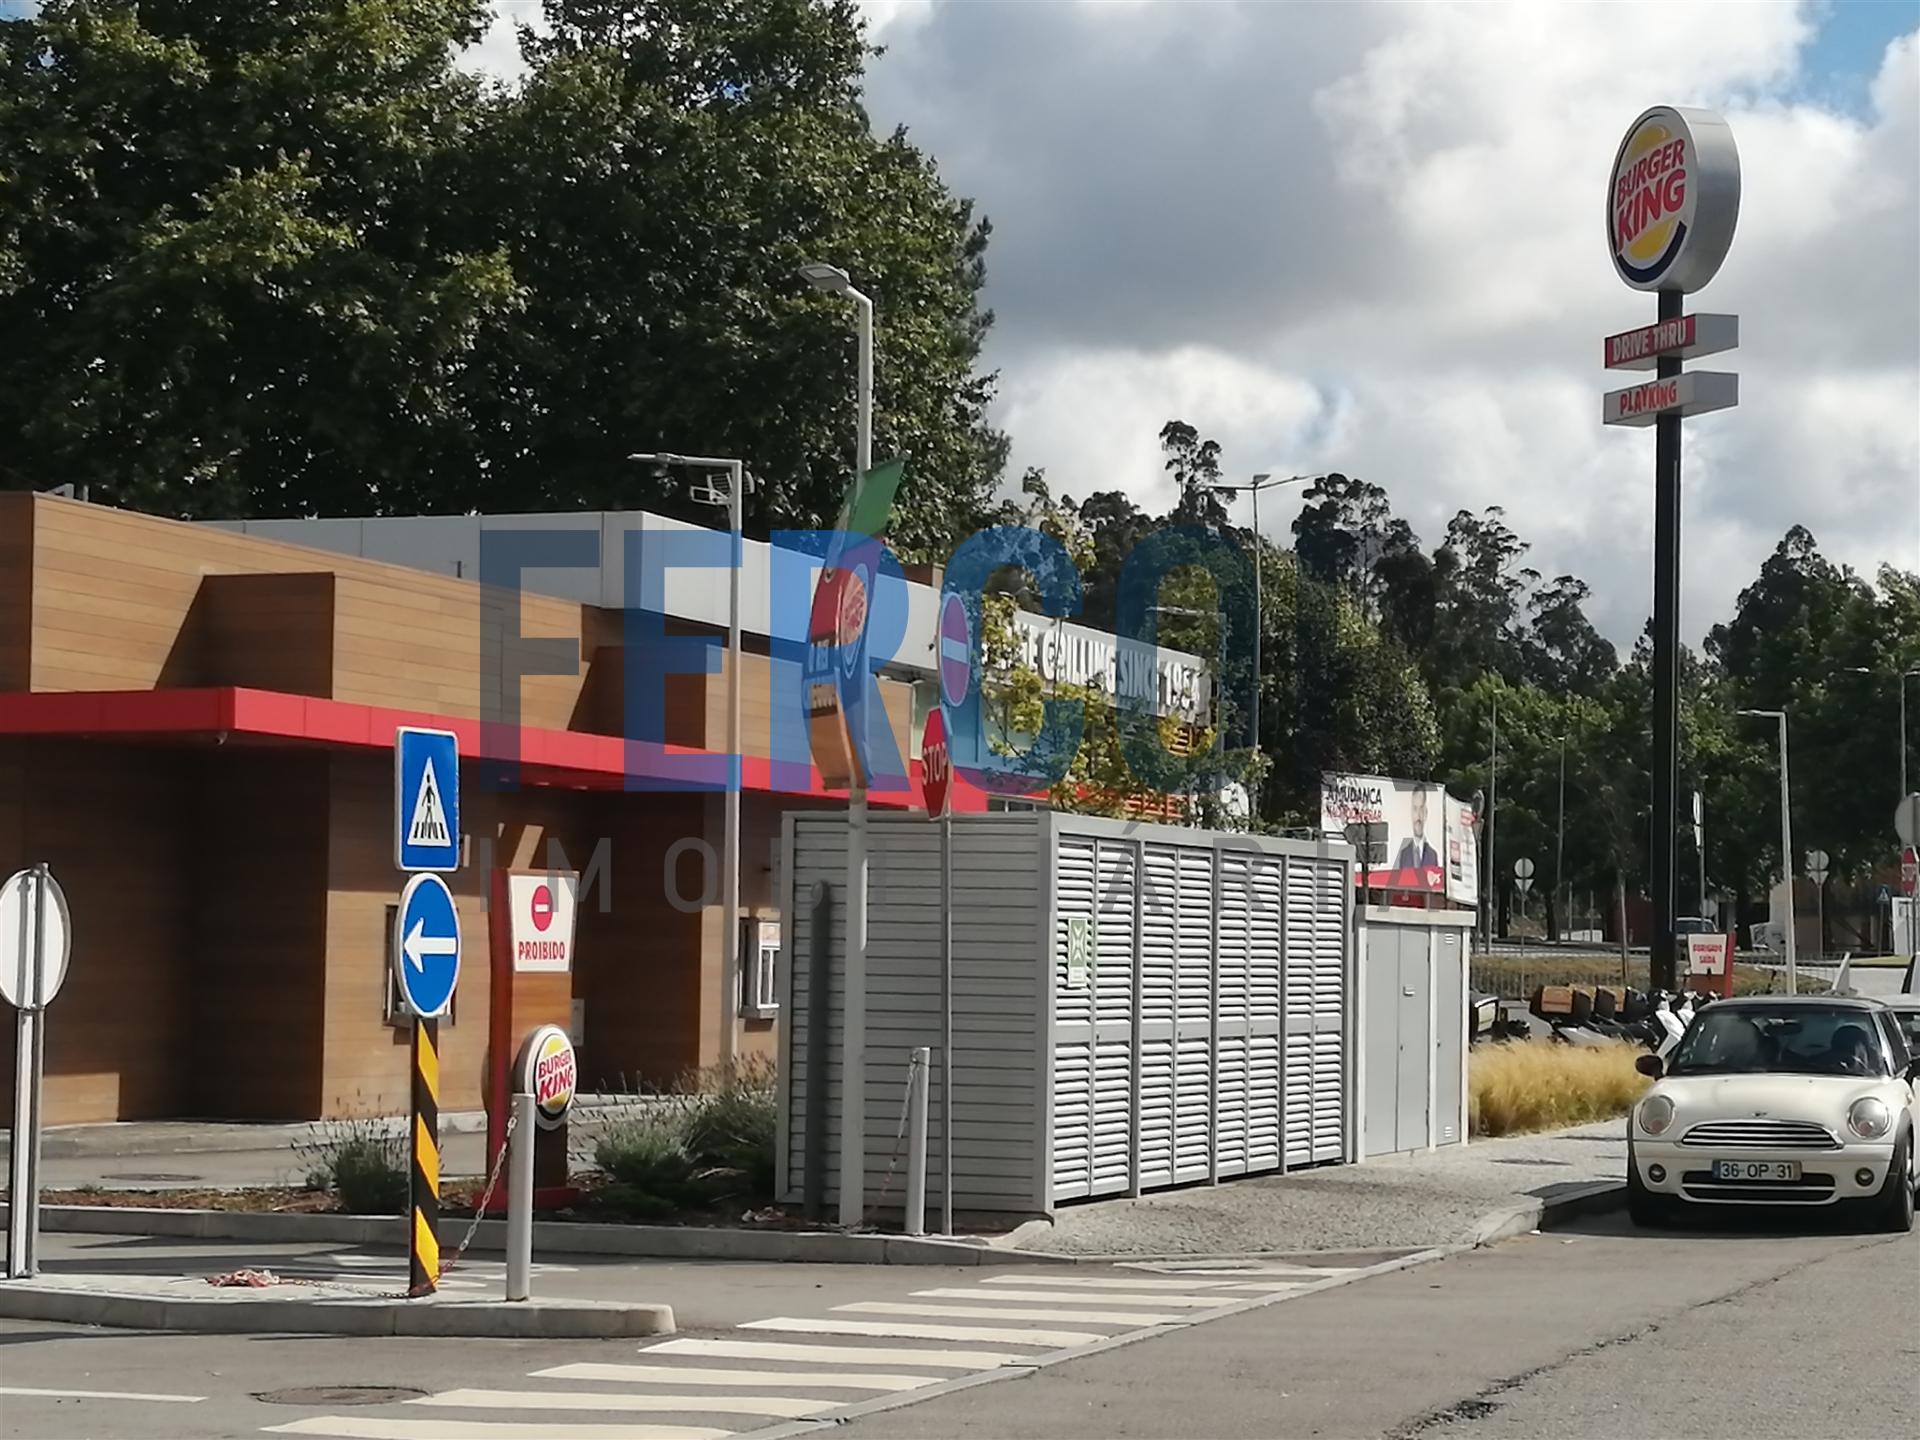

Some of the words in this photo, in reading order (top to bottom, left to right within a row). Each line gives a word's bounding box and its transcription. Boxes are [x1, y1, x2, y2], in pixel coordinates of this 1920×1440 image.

[1617, 139, 1685, 209] BURGER
[1617, 169, 1686, 253] KING
[1613, 329, 1649, 362] DRIVE
[1653, 319, 1687, 350] THRU
[1620, 381, 1677, 415] PLAYKING
[922, 743, 947, 785] STOP
[518, 940, 566, 961] PROIBIDO
[538, 1049, 571, 1079] BURGER
[537, 1066, 574, 1104] KING
